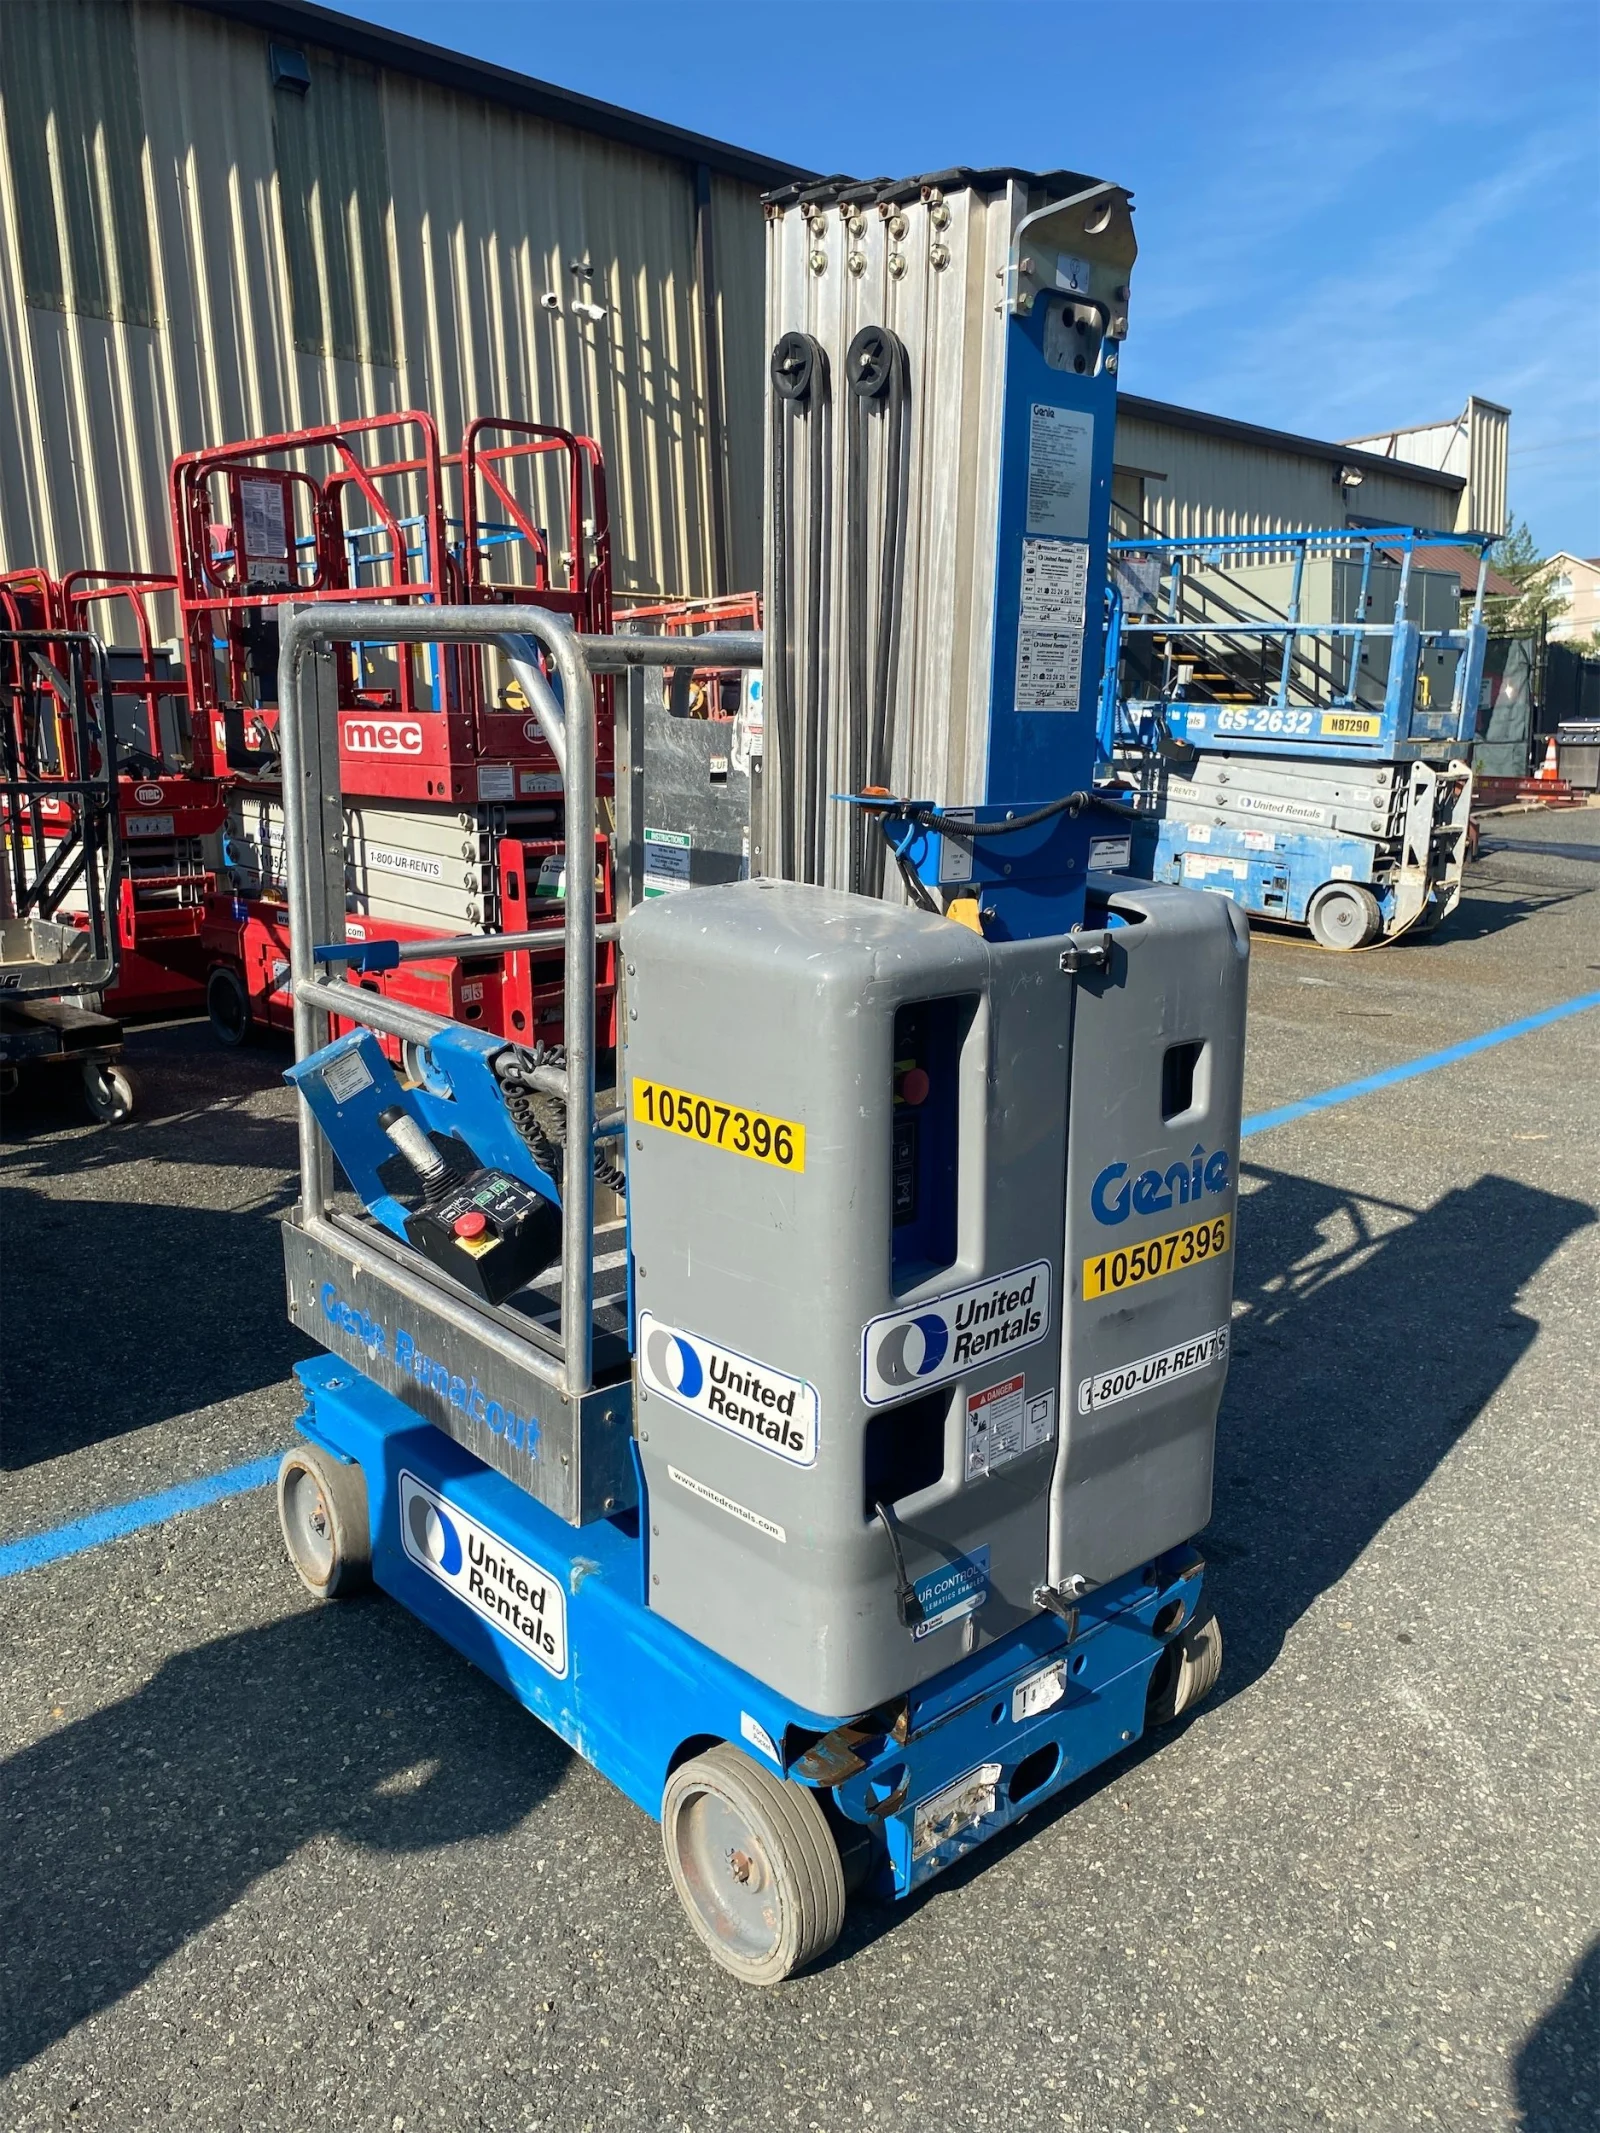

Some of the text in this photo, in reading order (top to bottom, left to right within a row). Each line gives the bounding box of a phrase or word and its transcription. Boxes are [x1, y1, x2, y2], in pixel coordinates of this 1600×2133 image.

[1033, 404, 1055, 418] Genie
[346, 723, 421, 750] mec
[527, 723, 546, 738] me
[1217, 708, 1313, 734] GS-2632
[1331, 718, 1370, 733] N87290
[138, 789, 161, 801] mec
[1252, 799, 1321, 819] United Rentals
[651, 832, 685, 845] INSTRUCTIONS
[370, 851, 440, 876] 1-800-UR-RENTS
[642, 1085, 794, 1165] 10507396
[1091, 1142, 1230, 1226] Genie
[1094, 1219, 1225, 1292] 10507396
[955, 1275, 1037, 1332] United
[952, 1307, 1042, 1364] Rentals
[320, 1281, 541, 1460] Genie Runabout
[708, 1355, 797, 1418] United
[1085, 1333, 1226, 1406] 1-800-UR-RENTS
[987, 1382, 1013, 1401] DANGER
[708, 1385, 806, 1452] Rentals
[674, 1471, 779, 1535] www.unitedrentals.com
[468, 1533, 546, 1616] United
[934, 1566, 979, 1595] CONTROL
[957, 1575, 985, 1596] ENABLED
[469, 1566, 556, 1656] Rentals
